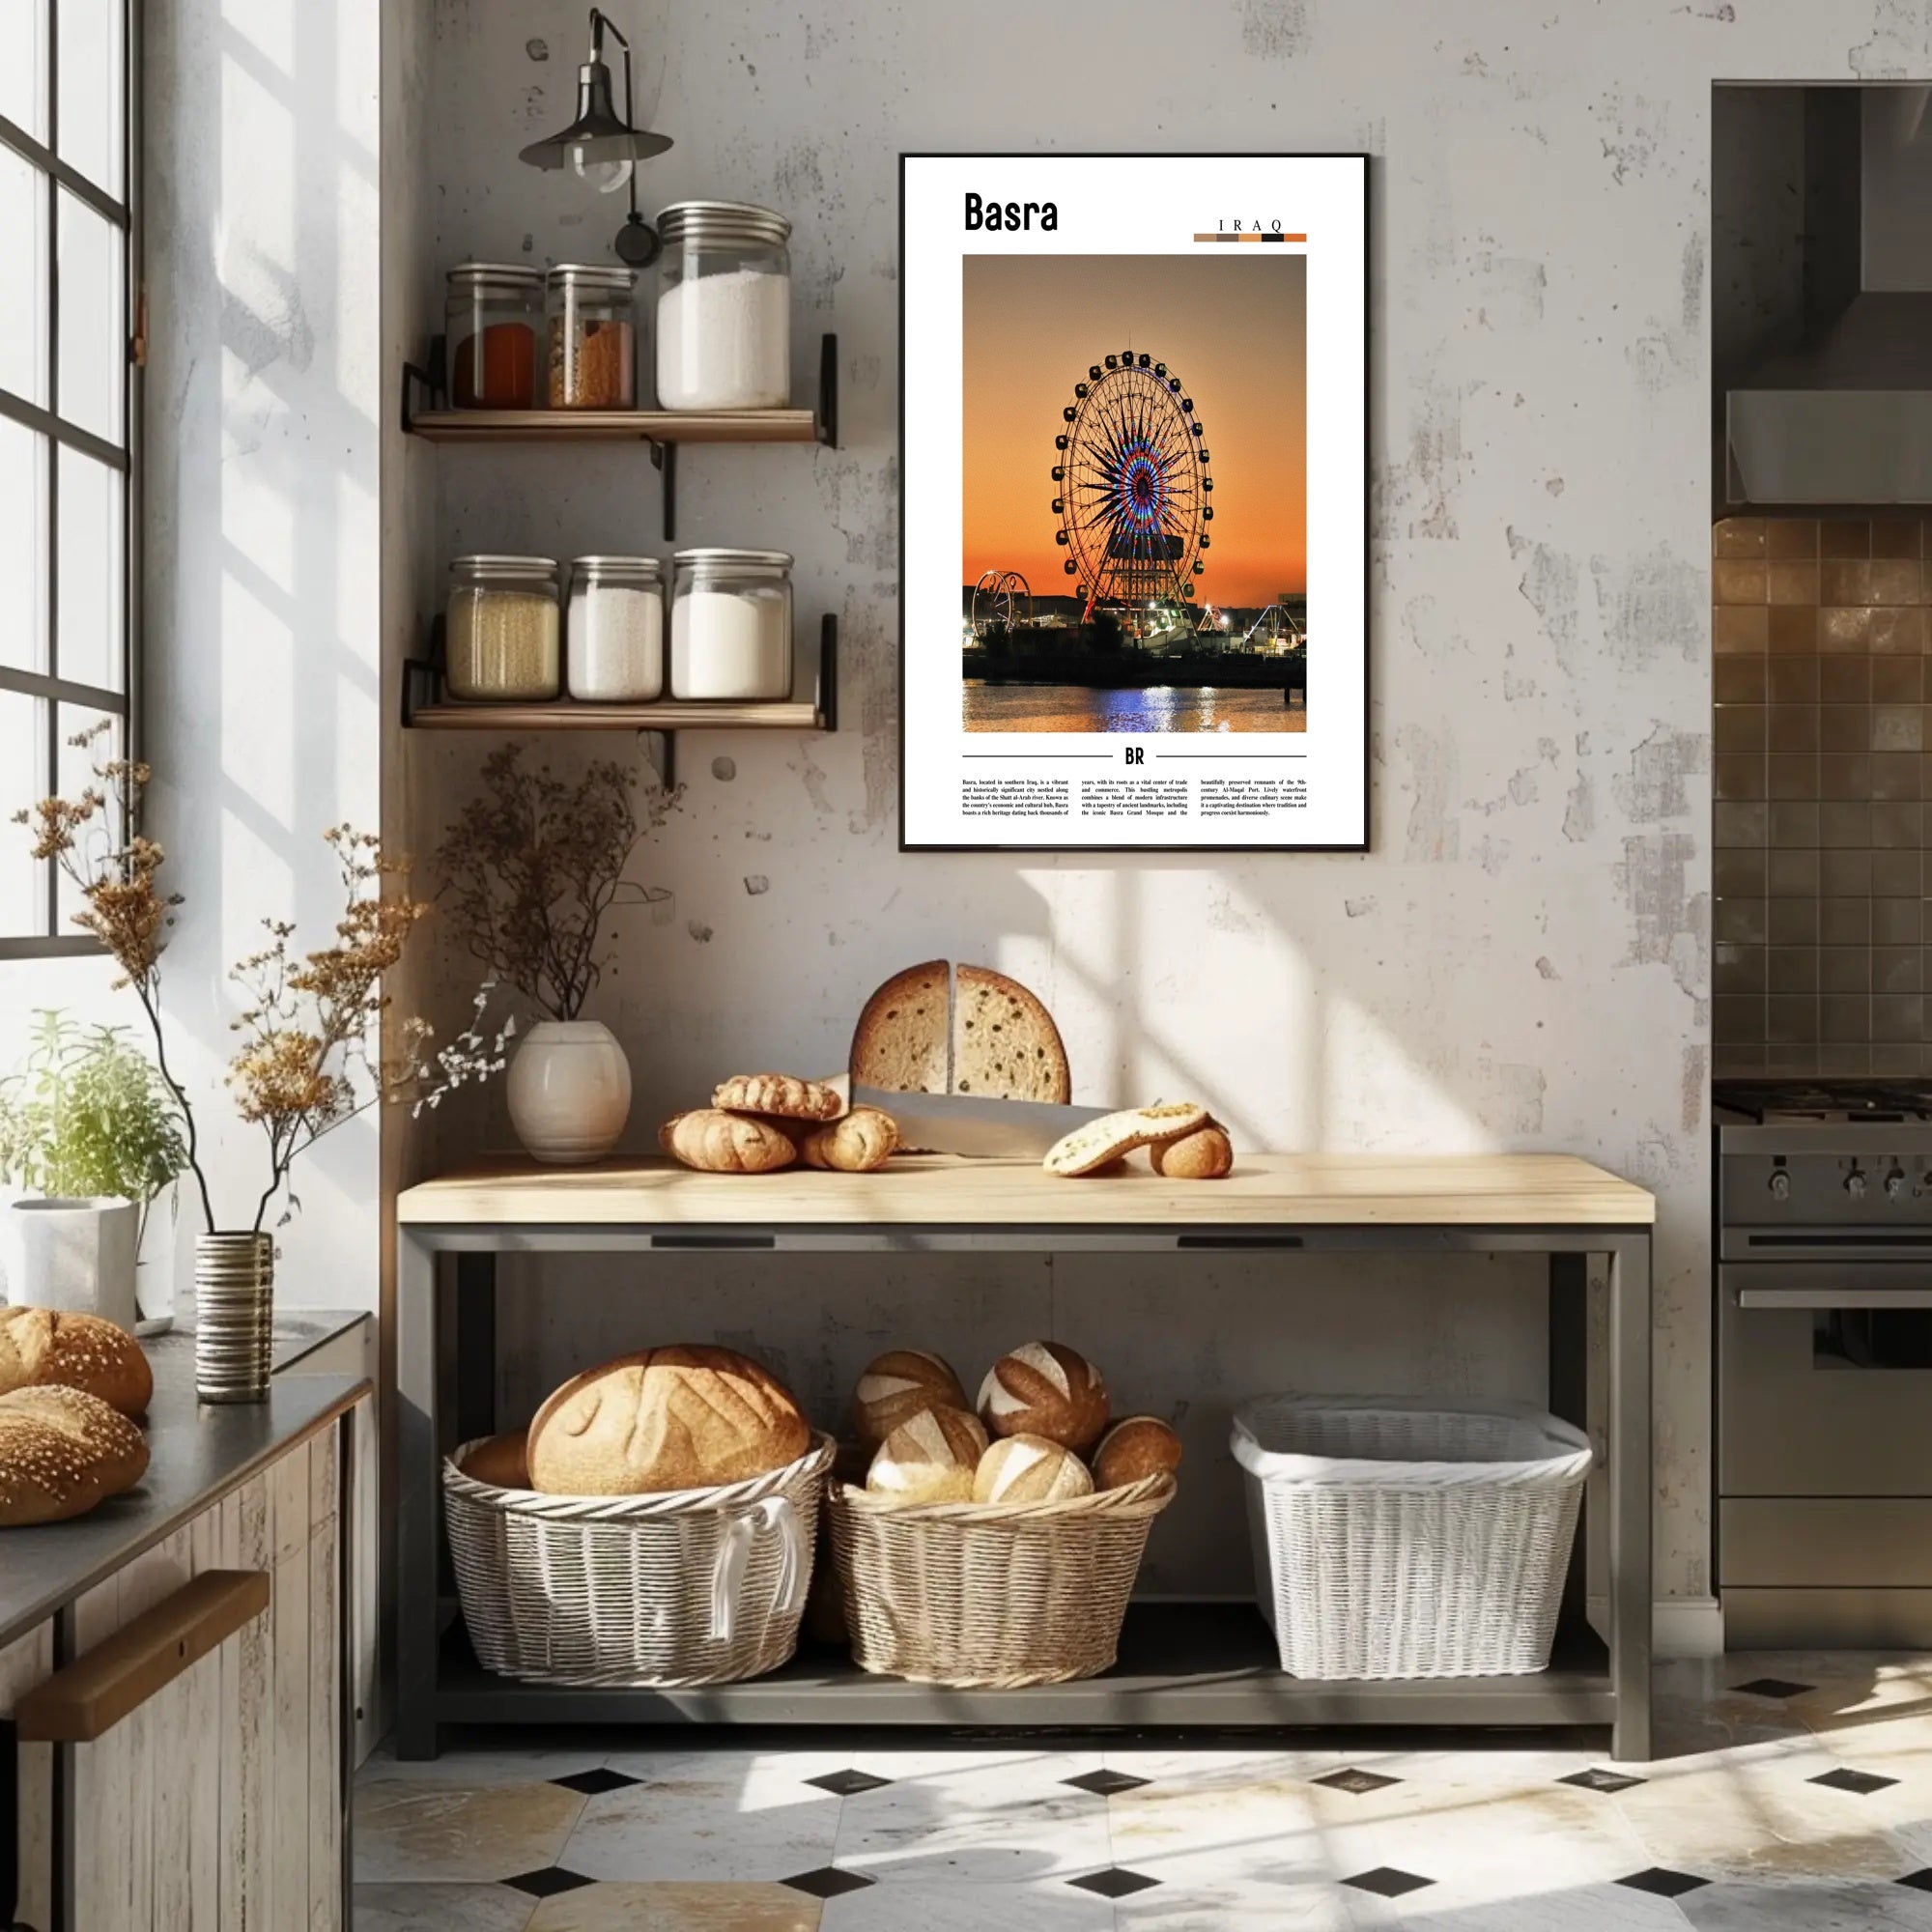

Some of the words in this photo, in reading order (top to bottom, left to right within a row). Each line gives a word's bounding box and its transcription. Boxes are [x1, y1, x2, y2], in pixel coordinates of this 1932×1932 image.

[965, 193, 1057, 231] Basra
[1220, 220, 1281, 232] IRAQ
[1126, 747, 1144, 764] BR
